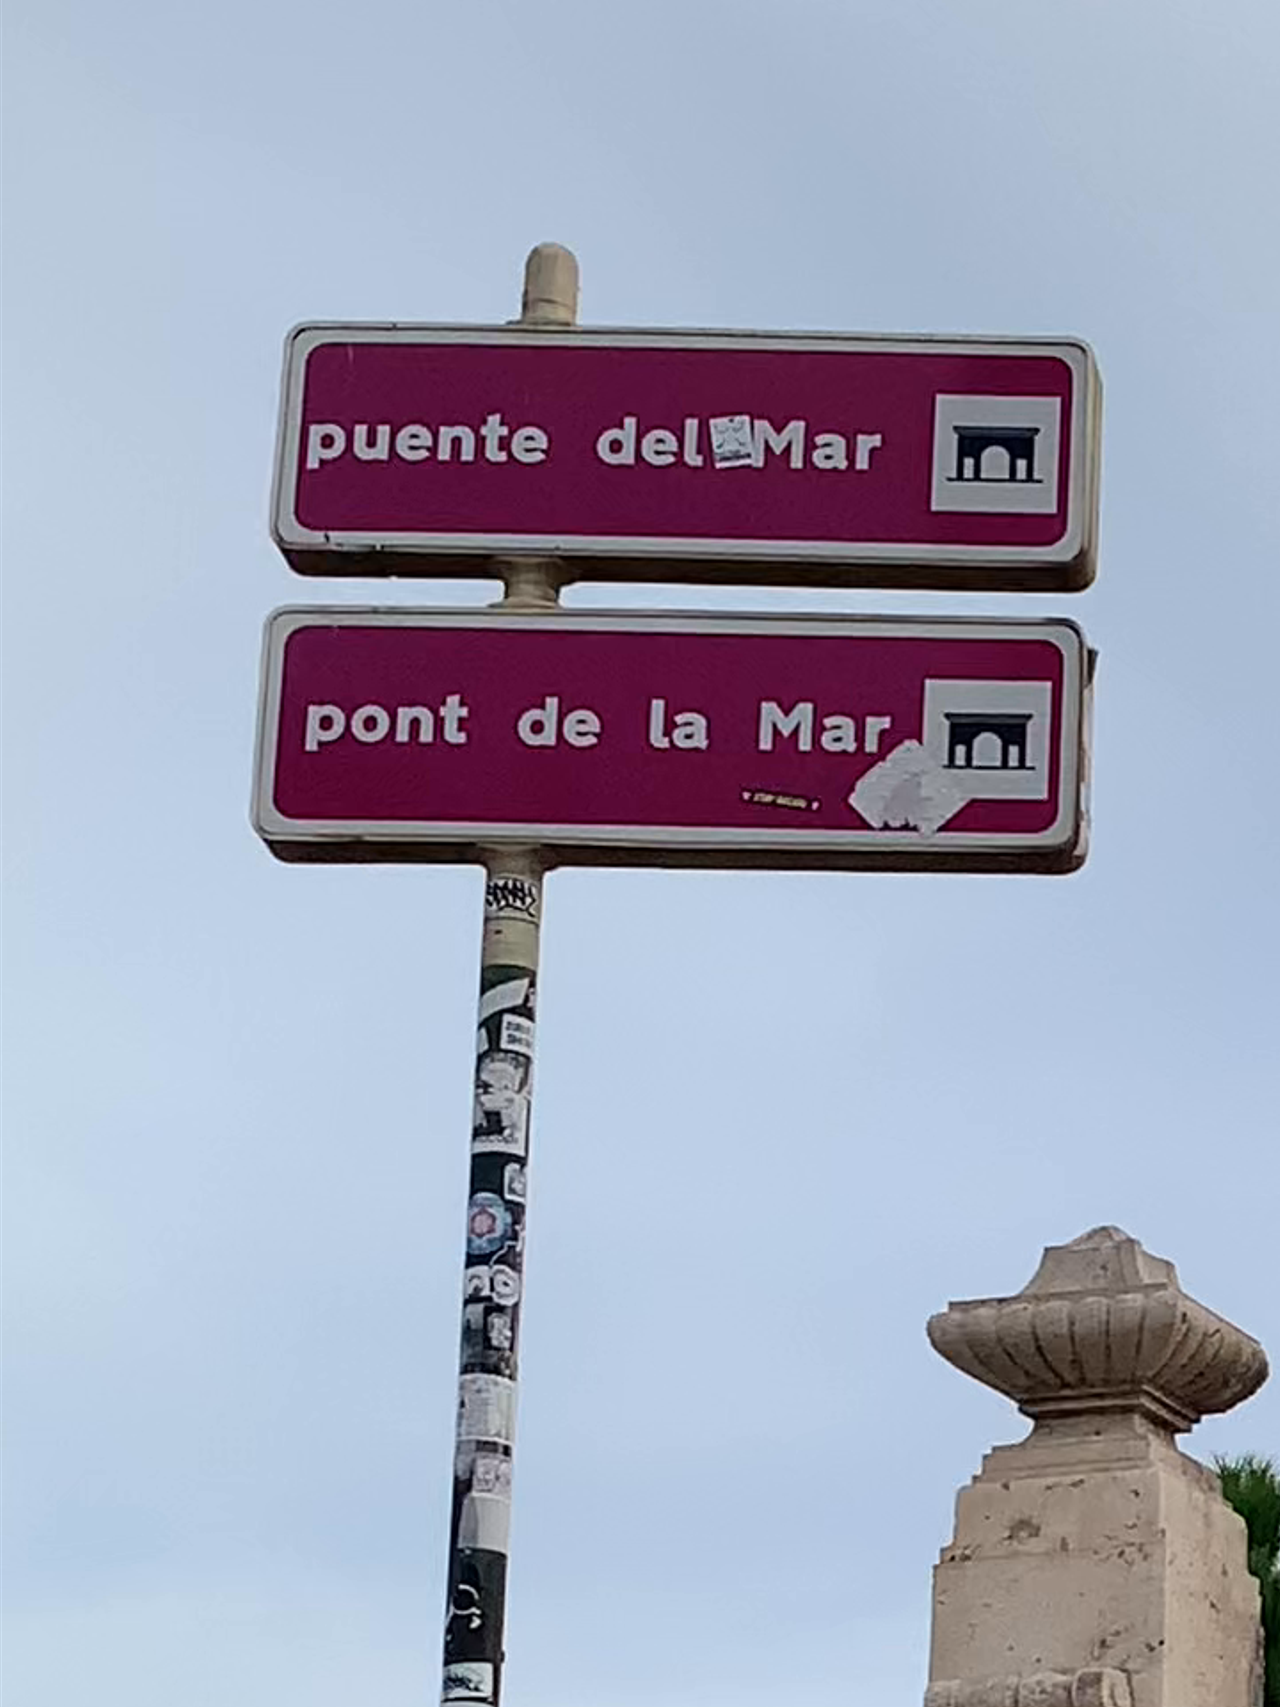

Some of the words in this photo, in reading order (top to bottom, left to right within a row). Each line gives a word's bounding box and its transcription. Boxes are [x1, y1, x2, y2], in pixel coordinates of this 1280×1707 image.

[306, 412, 549, 470] puente
[596, 416, 703, 467] del
[753, 419, 883, 470] Mar
[305, 694, 469, 753] pont
[517, 696, 601, 747] de
[649, 698, 710, 750] la
[758, 701, 892, 753] Mar
